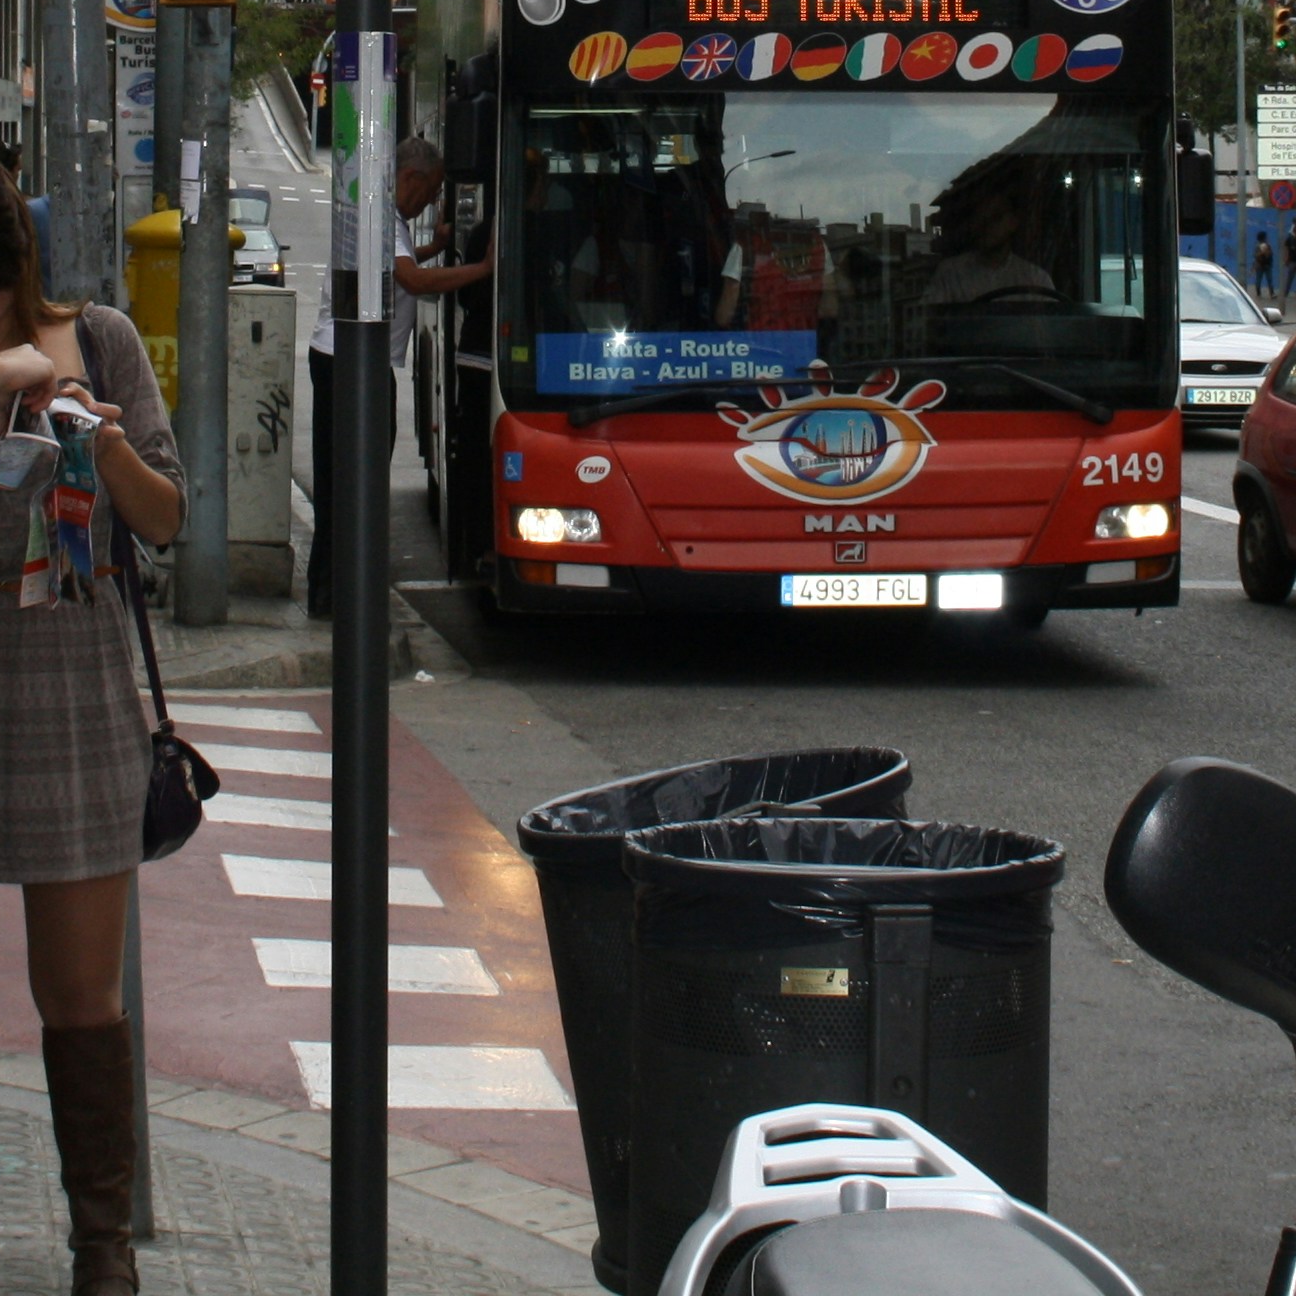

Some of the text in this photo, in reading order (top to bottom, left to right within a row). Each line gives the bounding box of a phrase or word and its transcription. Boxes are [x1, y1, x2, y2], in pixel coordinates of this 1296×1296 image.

[119, 35, 156, 45] Barcel
[1271, 125, 1289, 133] Parc
[1271, 152, 1281, 160] de
[680, 339, 750, 358] Route
[569, 362, 635, 380] Blava
[658, 362, 709, 380] Azul
[731, 361, 784, 379] Blue
[1197, 390, 1252, 402] 2912 BZR
[583, 465, 606, 474] TMB
[1081, 451, 1164, 487] 2149
[804, 513, 896, 533] MAN
[799, 578, 921, 601] 4993 FGL
